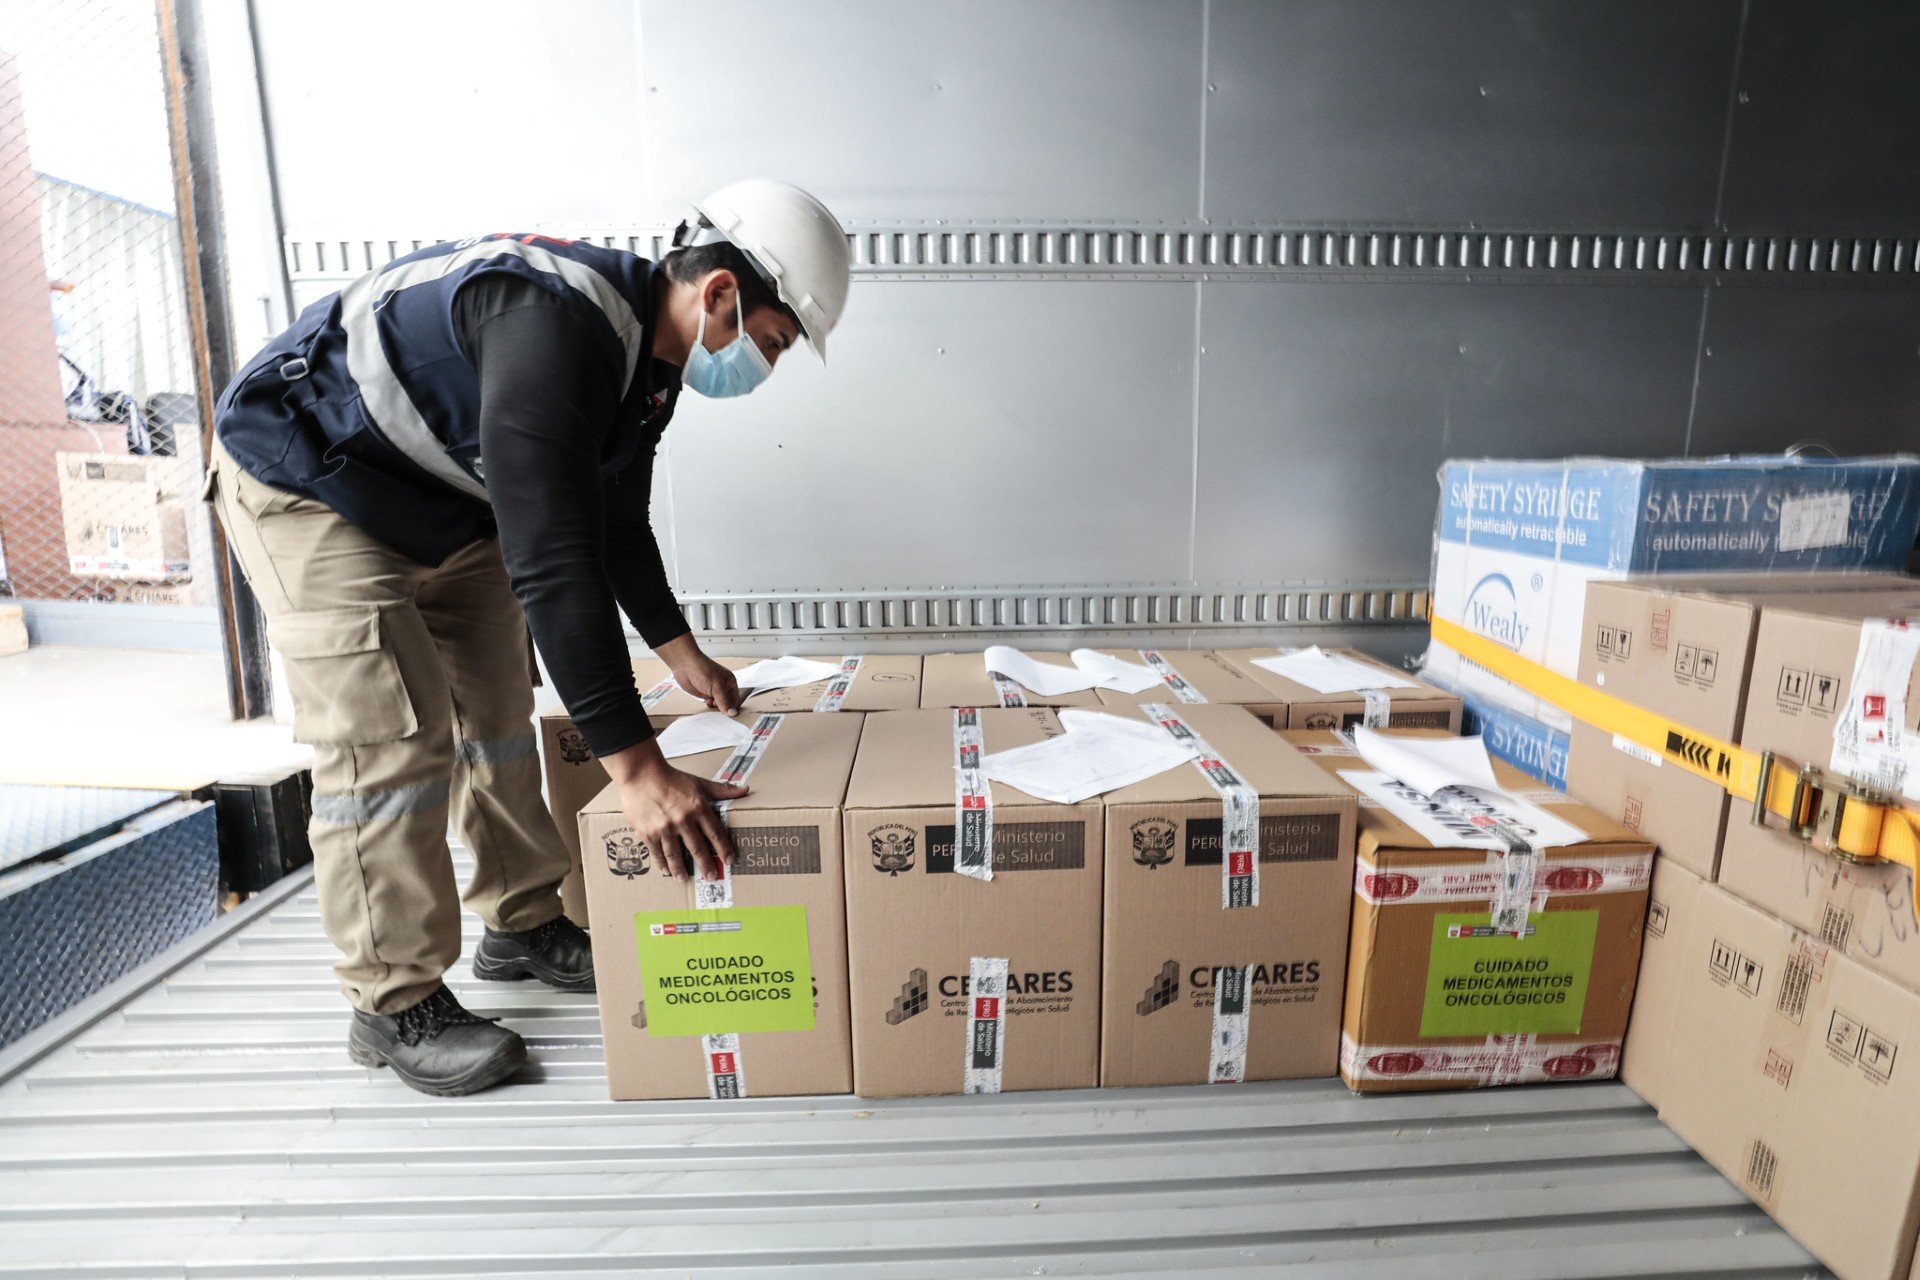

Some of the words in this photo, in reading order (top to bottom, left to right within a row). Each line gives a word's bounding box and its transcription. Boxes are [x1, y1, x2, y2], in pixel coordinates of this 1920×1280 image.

[1450, 479, 1513, 513] SAFETY
[1644, 486, 1763, 524] SAFETY
[1455, 516, 1519, 540] auomatically
[1653, 529, 1770, 554] automatically
[1473, 601, 1529, 653] Wealy
[965, 825, 974, 847] Salud
[1260, 822, 1321, 836] inisterio
[732, 832, 800, 847] inisterio
[1011, 848, 1054, 864] Salud
[1267, 840, 1310, 856] Salud
[746, 852, 790, 867] Salud
[686, 955, 764, 971] CUIDADO
[1473, 959, 1549, 974] CUIDADO
[658, 970, 795, 988] MEDICAMENTOS
[1189, 960, 1321, 989] CARES
[938, 971, 1074, 998] CEARES
[1252, 986, 1262, 996] de
[1264, 985, 1319, 996] Abastecimiento
[1442, 975, 1573, 991] MEDICAMENTOS
[665, 987, 791, 1005] ONCOLÓGICOS
[940, 999, 967, 1008] Centro
[1016, 995, 1073, 1006] Abastecimiento
[1293, 995, 1315, 1004] Salud
[1445, 991, 1566, 1007] ONCOLÓGICOS
[944, 1008, 954, 1018] de
[1048, 1003, 1070, 1013] Salud
[976, 1033, 985, 1052] Salud
[984, 1021, 994, 1057] Ministerio
